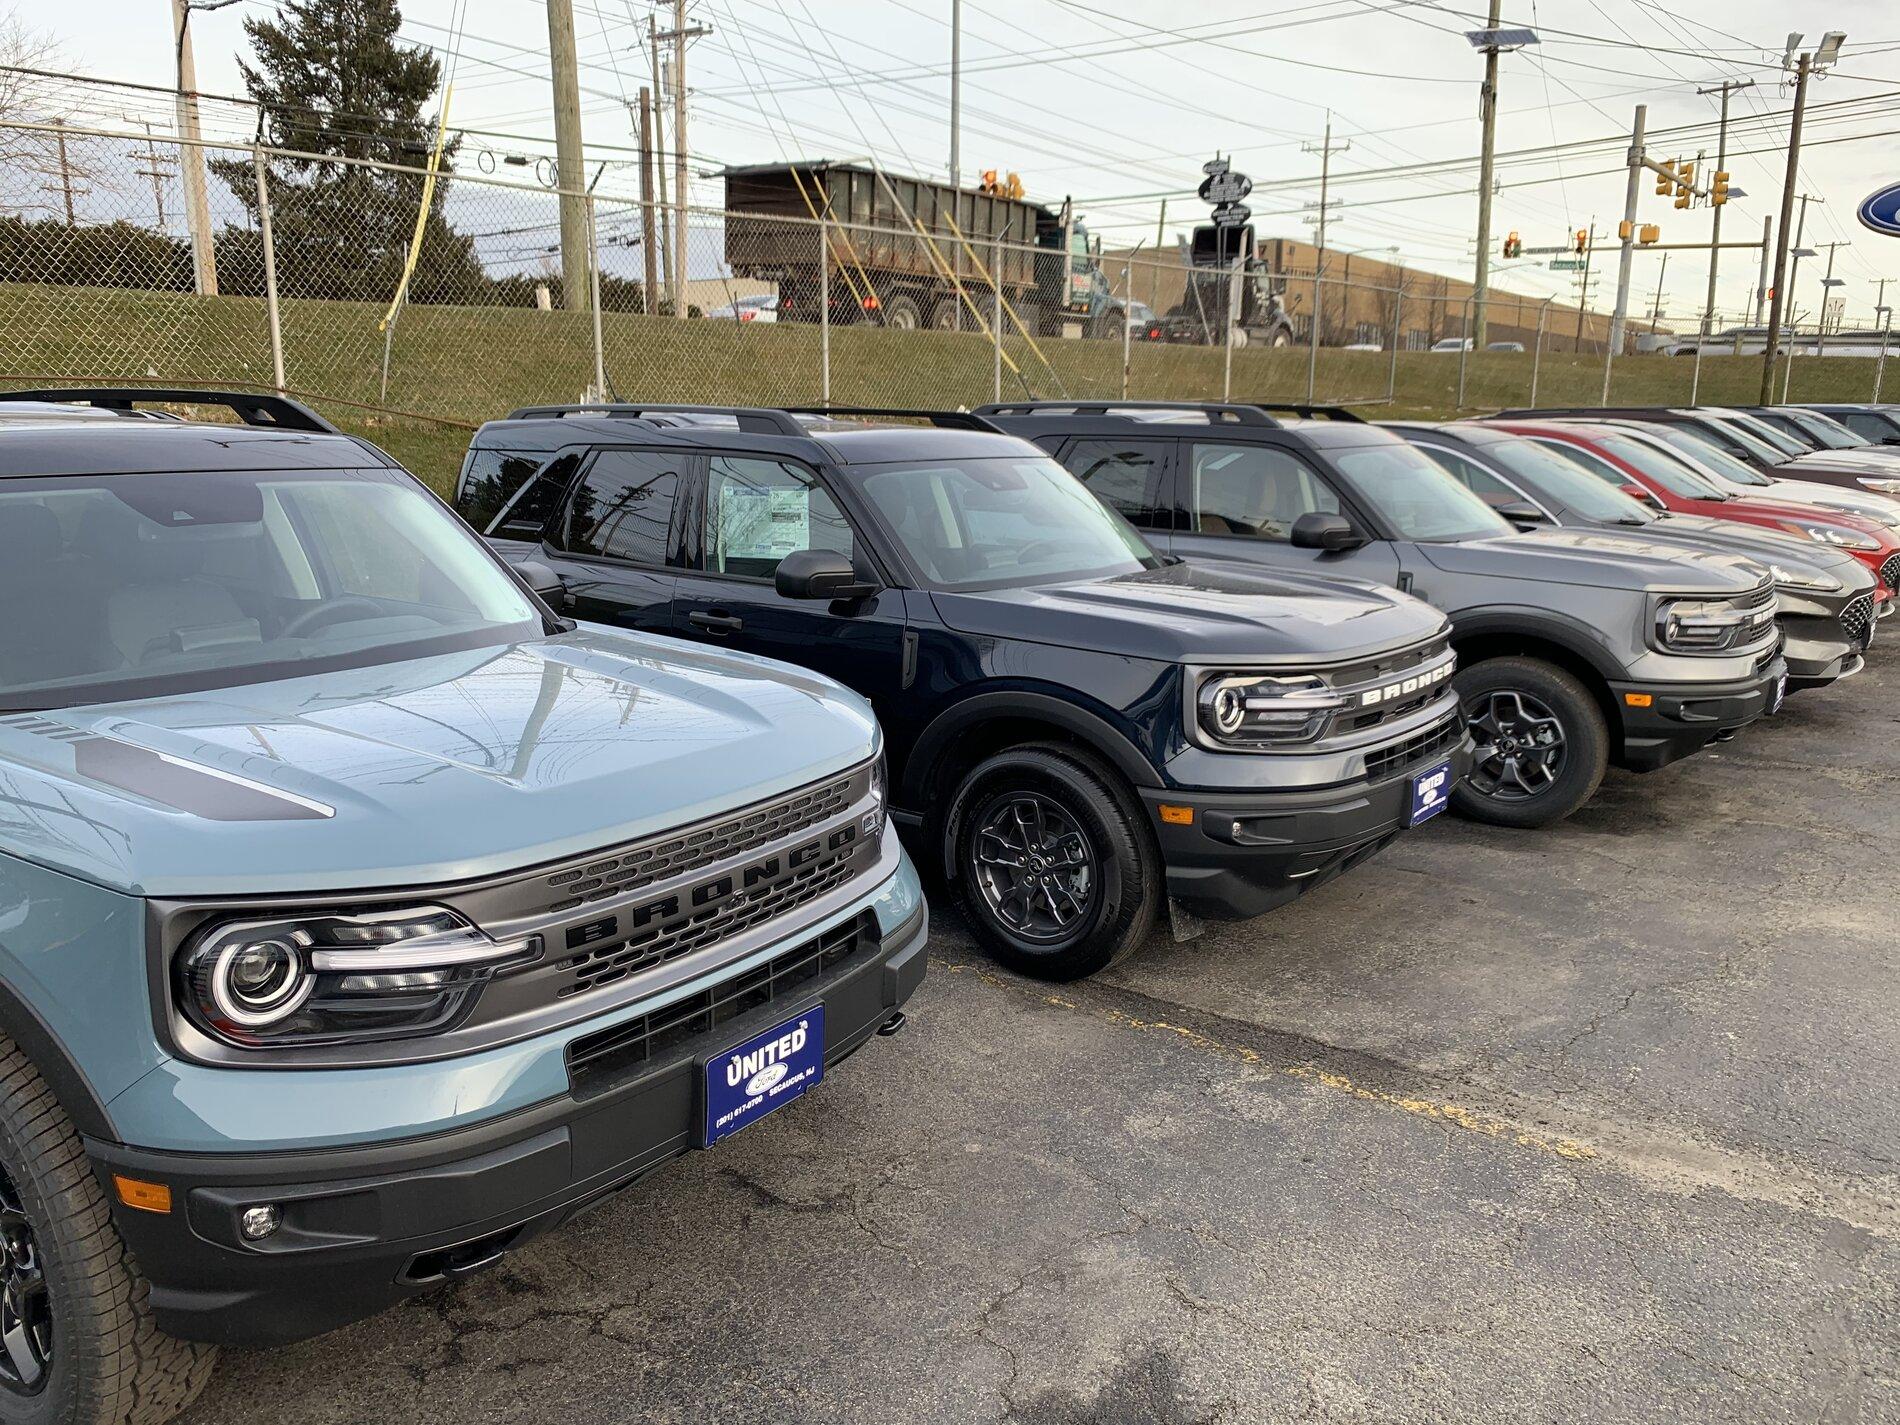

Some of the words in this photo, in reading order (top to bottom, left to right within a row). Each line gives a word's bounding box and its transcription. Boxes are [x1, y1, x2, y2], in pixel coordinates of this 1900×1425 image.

[1362, 661, 1453, 706] BRONCO
[565, 825, 855, 949] BRONCO
[727, 1028, 806, 1087] UNITED
[716, 1111, 734, 1129] (201)
[769, 1071, 805, 1097] SECAUCUS,
[805, 1065, 815, 1078] NJ
